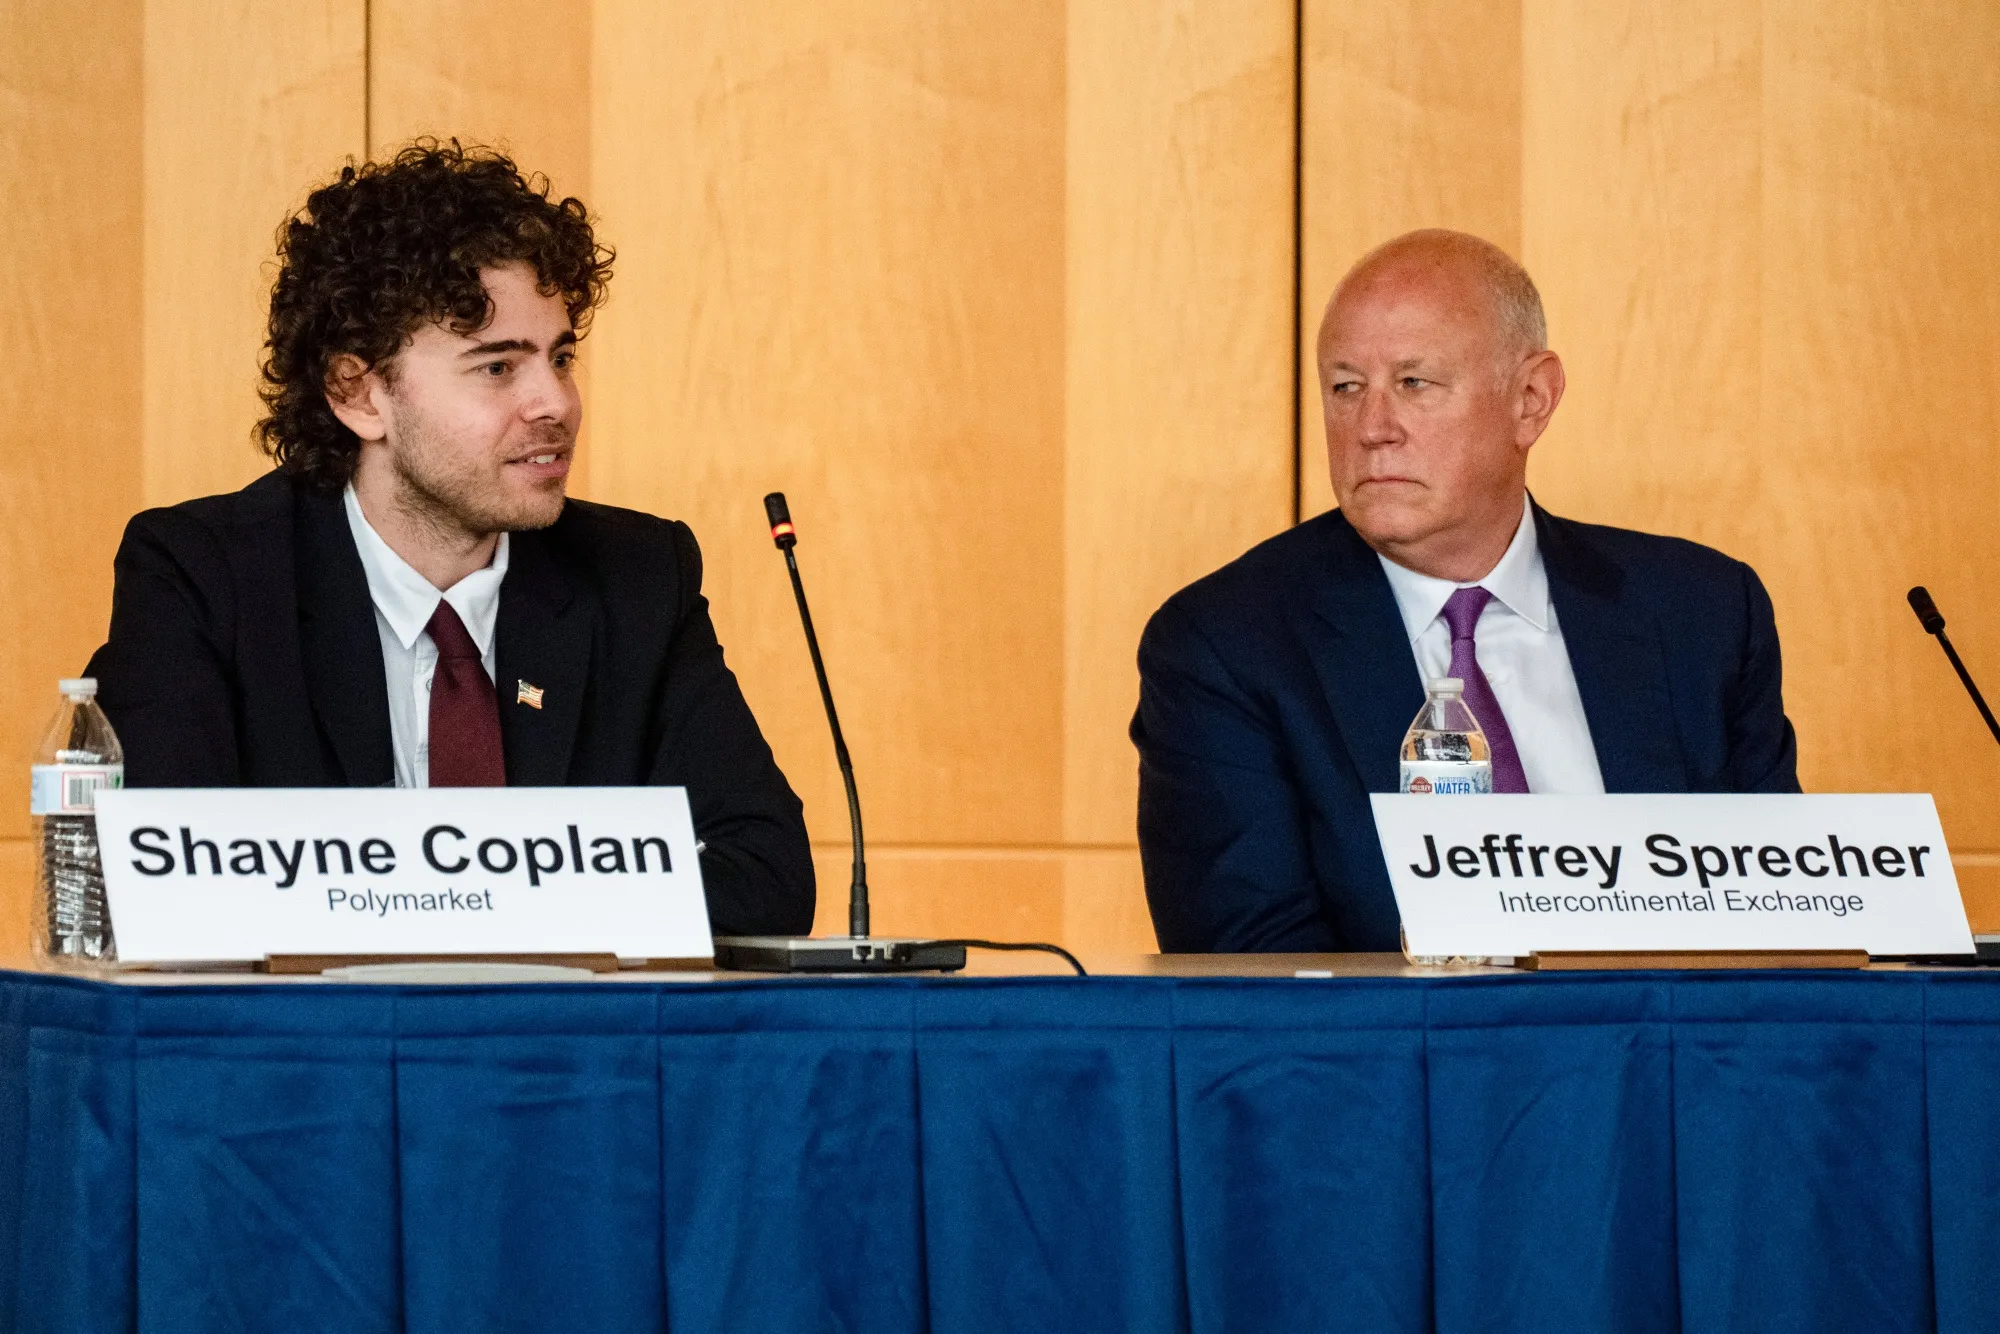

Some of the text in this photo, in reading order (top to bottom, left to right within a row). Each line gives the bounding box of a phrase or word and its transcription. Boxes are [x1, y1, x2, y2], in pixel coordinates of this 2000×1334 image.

[1434, 782, 1470, 794] WATER
[129, 824, 673, 889] Shayne Coplan
[1408, 833, 1931, 890] Jeffrey Sprecher
[327, 888, 493, 917] Polymarket
[1498, 889, 1864, 917] Intercontinental Exchange
